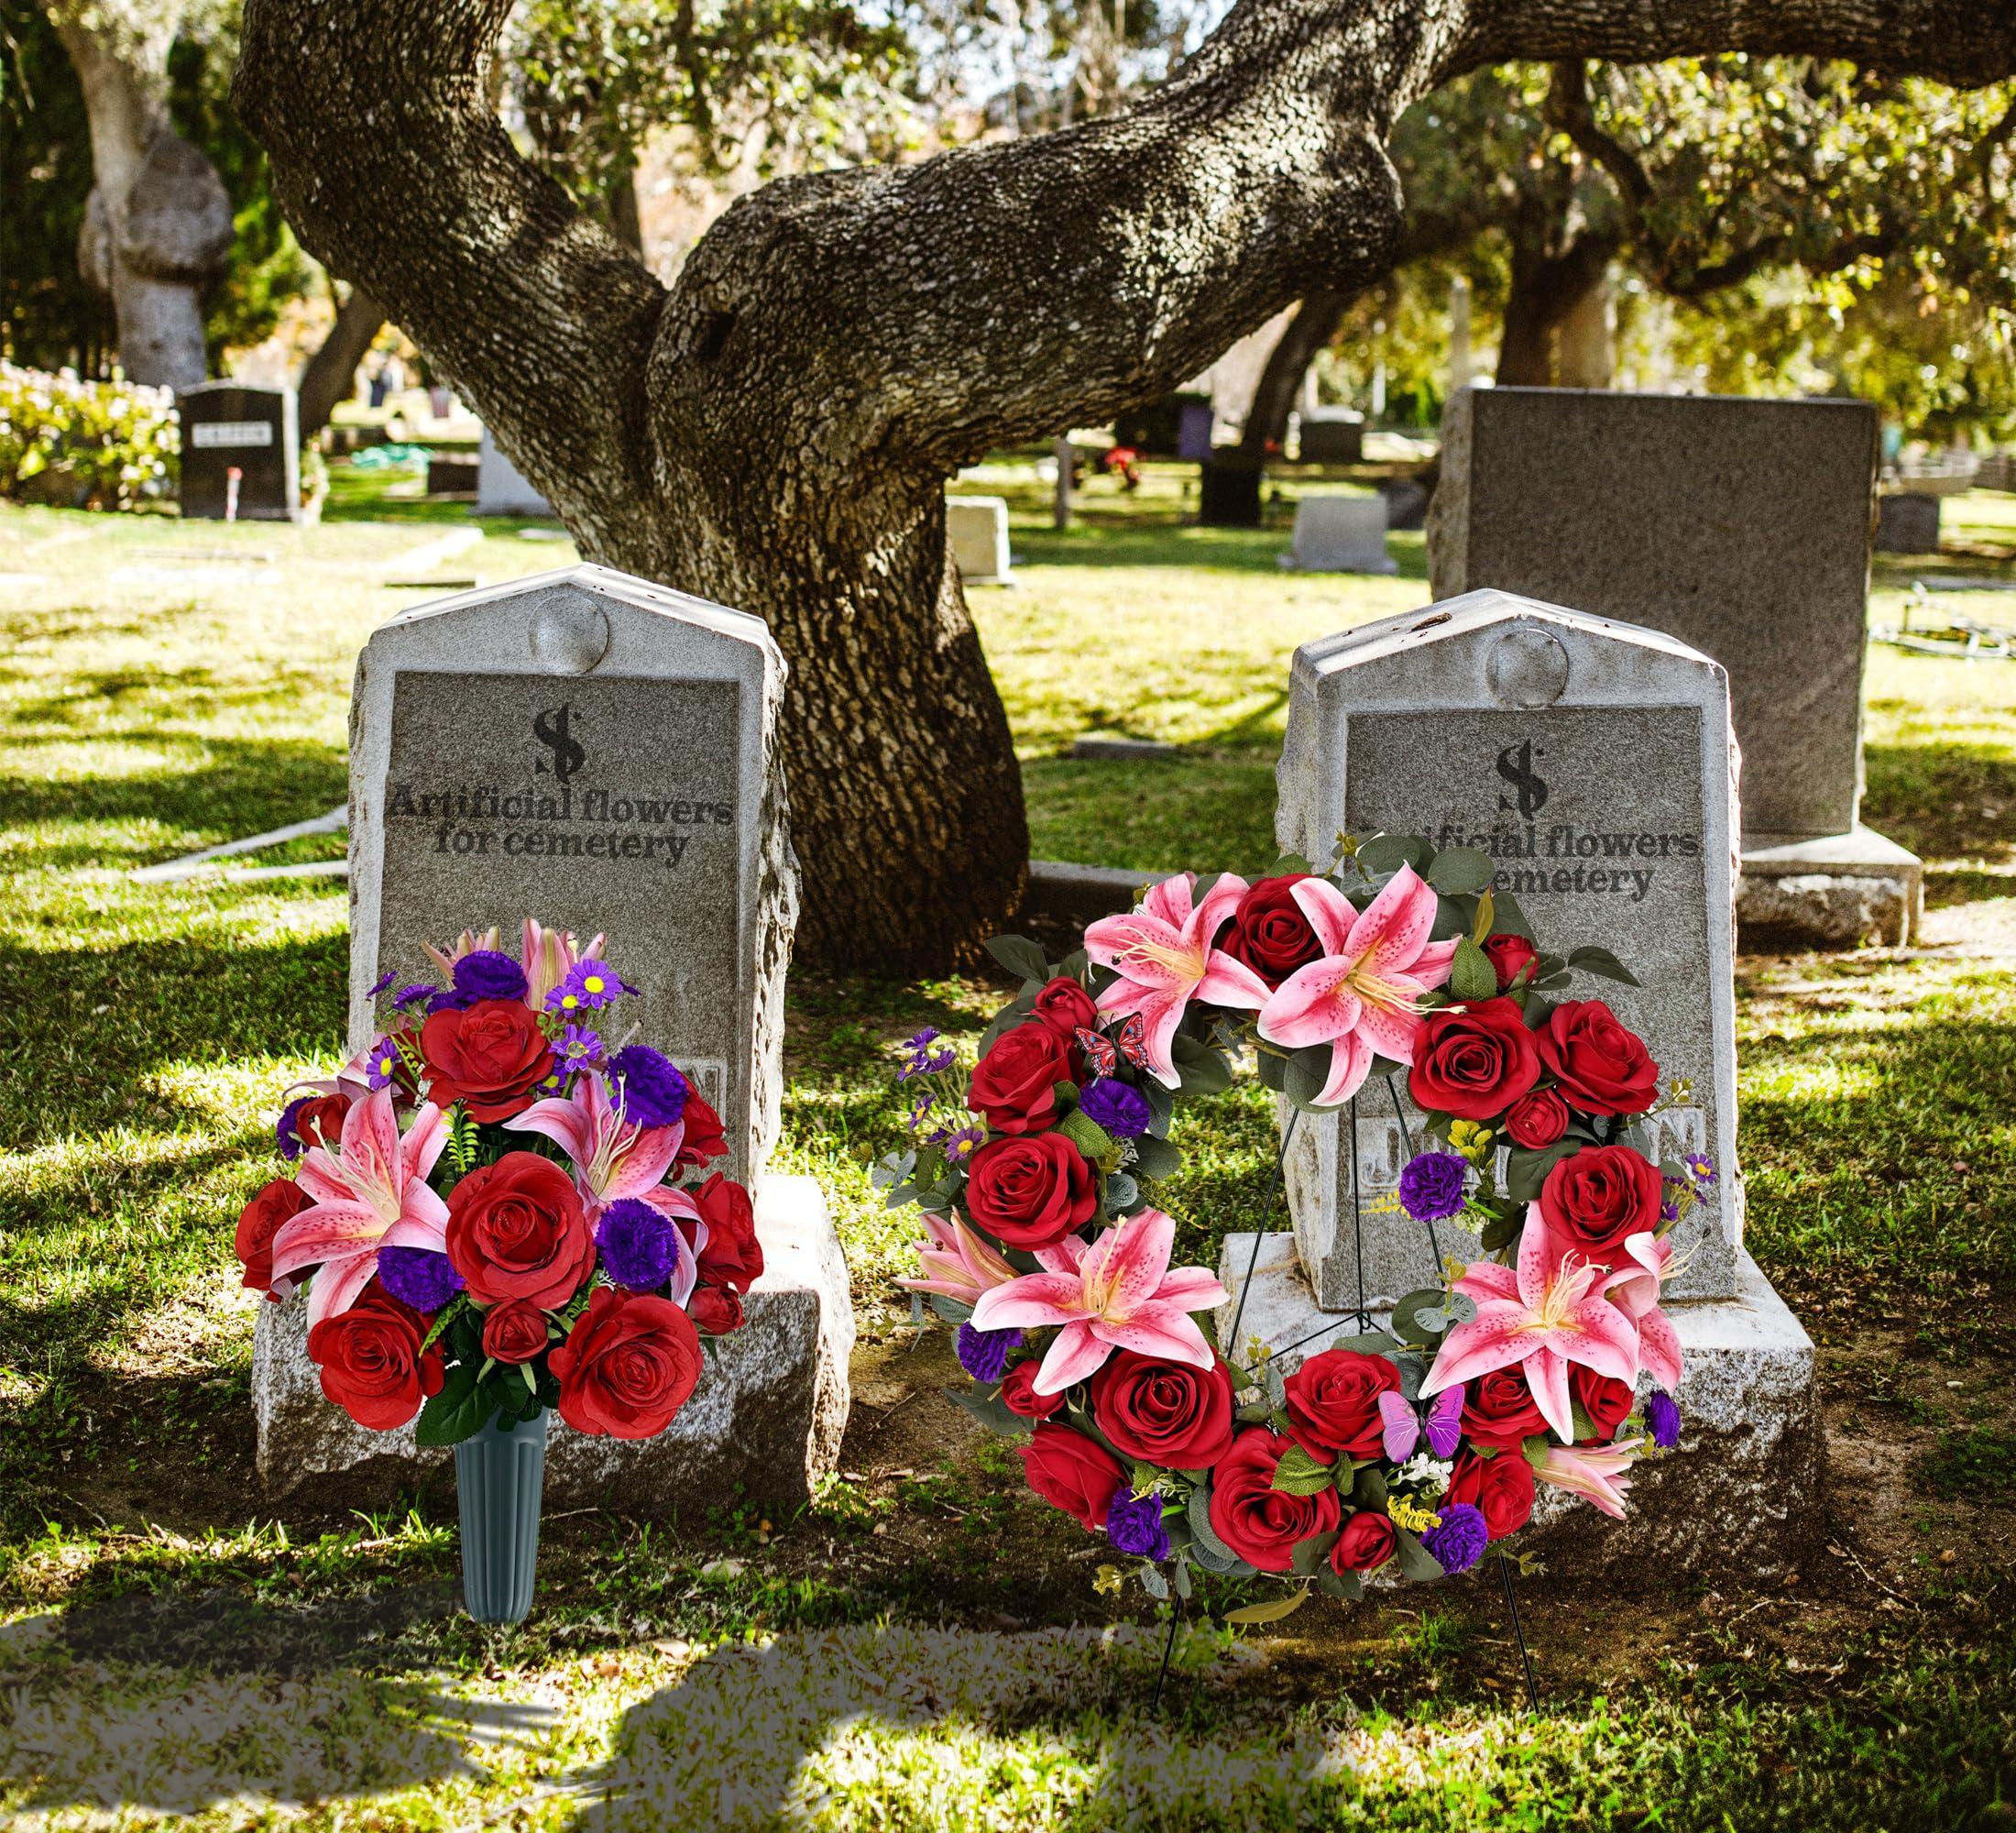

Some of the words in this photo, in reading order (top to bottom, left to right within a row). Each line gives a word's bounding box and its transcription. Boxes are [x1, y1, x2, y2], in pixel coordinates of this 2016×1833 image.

[384, 785, 572, 820] Artificial
[579, 789, 734, 826] flowers
[433, 820, 499, 854] for
[503, 827, 691, 869] cemetery
[1545, 824, 1698, 858] flowers
[1474, 864, 1657, 903] emetery
